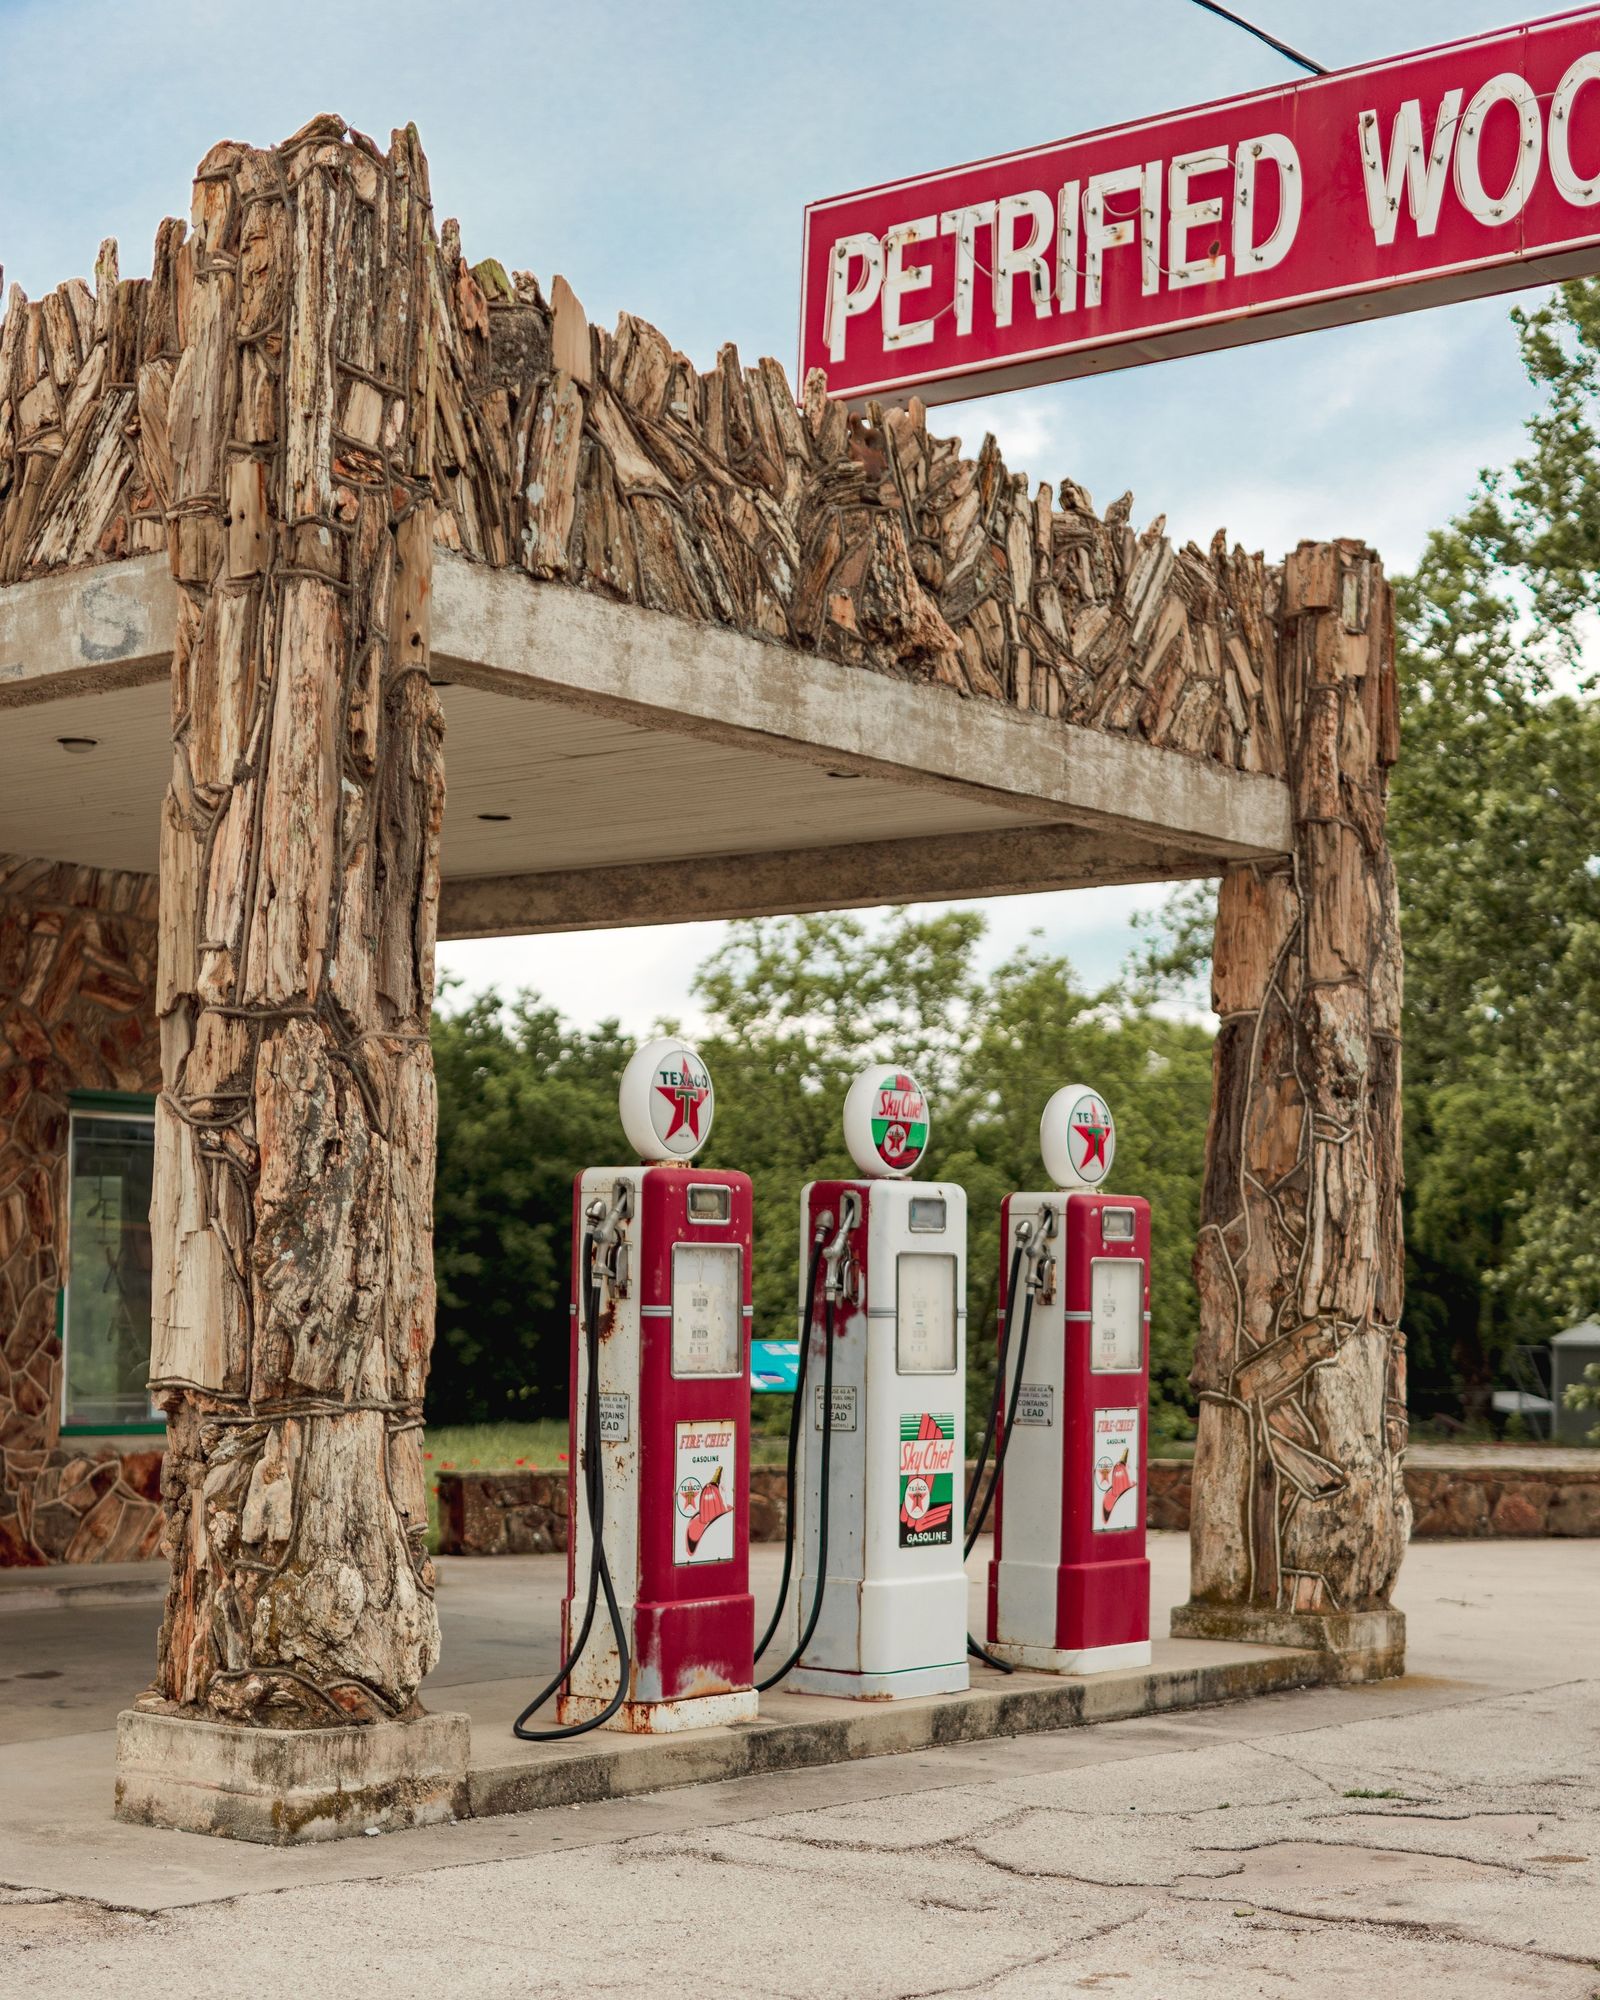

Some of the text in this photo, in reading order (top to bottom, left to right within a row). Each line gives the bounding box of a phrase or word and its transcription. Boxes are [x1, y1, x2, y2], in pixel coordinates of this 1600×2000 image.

[824, 132, 1303, 364] PETRIFIED
[660, 1071, 708, 1088] TEXACO
[879, 1090, 901, 1119] Sky
[831, 1412, 847, 1421] EAD
[1022, 1408, 1044, 1417] LEAD
[601, 1421, 619, 1431] EAD
[680, 1433, 731, 1449] FIRE-CHIEF
[692, 1455, 719, 1463] GASOLINE
[900, 1439, 954, 1474] Sky Chief
[681, 1484, 700, 1492] TEXACO
[906, 1532, 947, 1543] GASOLINE
